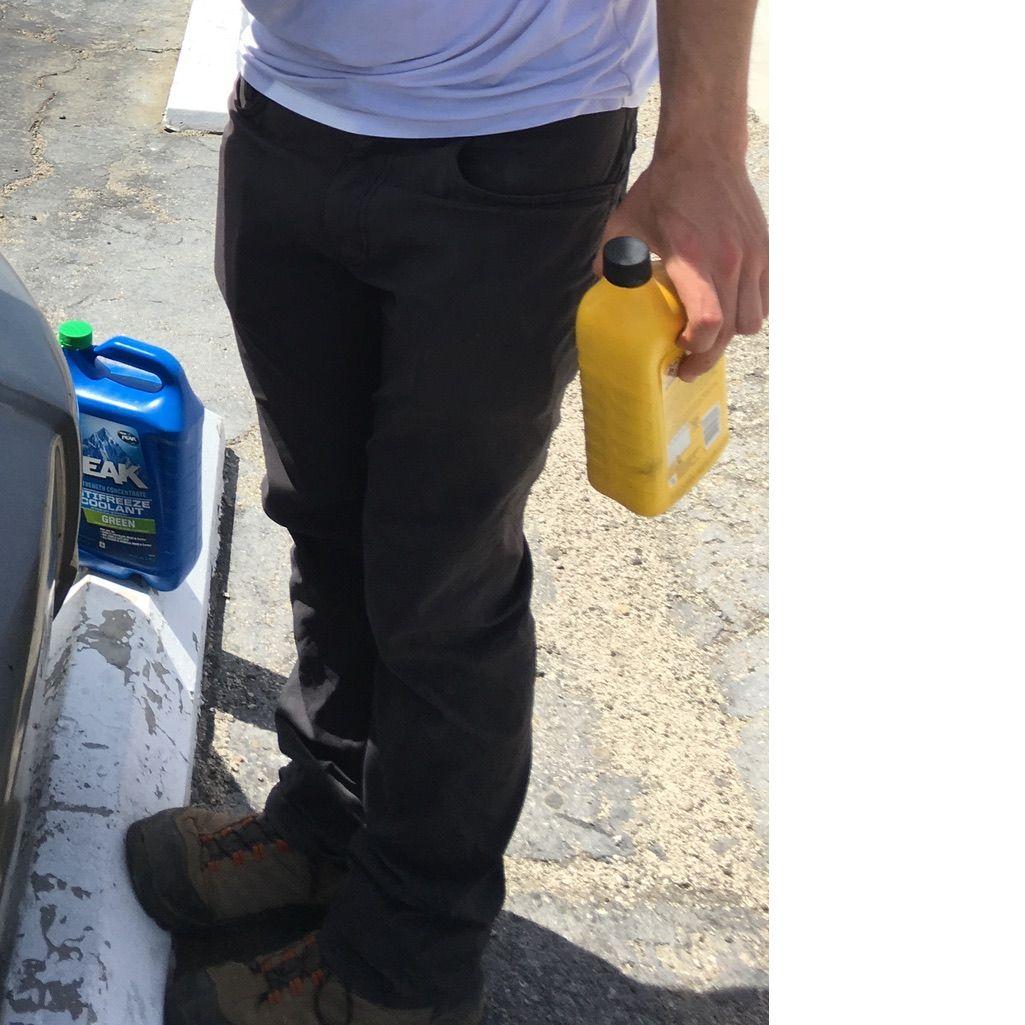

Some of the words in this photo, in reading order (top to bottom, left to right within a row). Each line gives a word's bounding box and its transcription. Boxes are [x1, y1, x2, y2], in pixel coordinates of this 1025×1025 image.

[82, 455, 148, 489] EAK
[82, 490, 151, 509] TIFREEZE
[101, 514, 136, 528] GREEN
